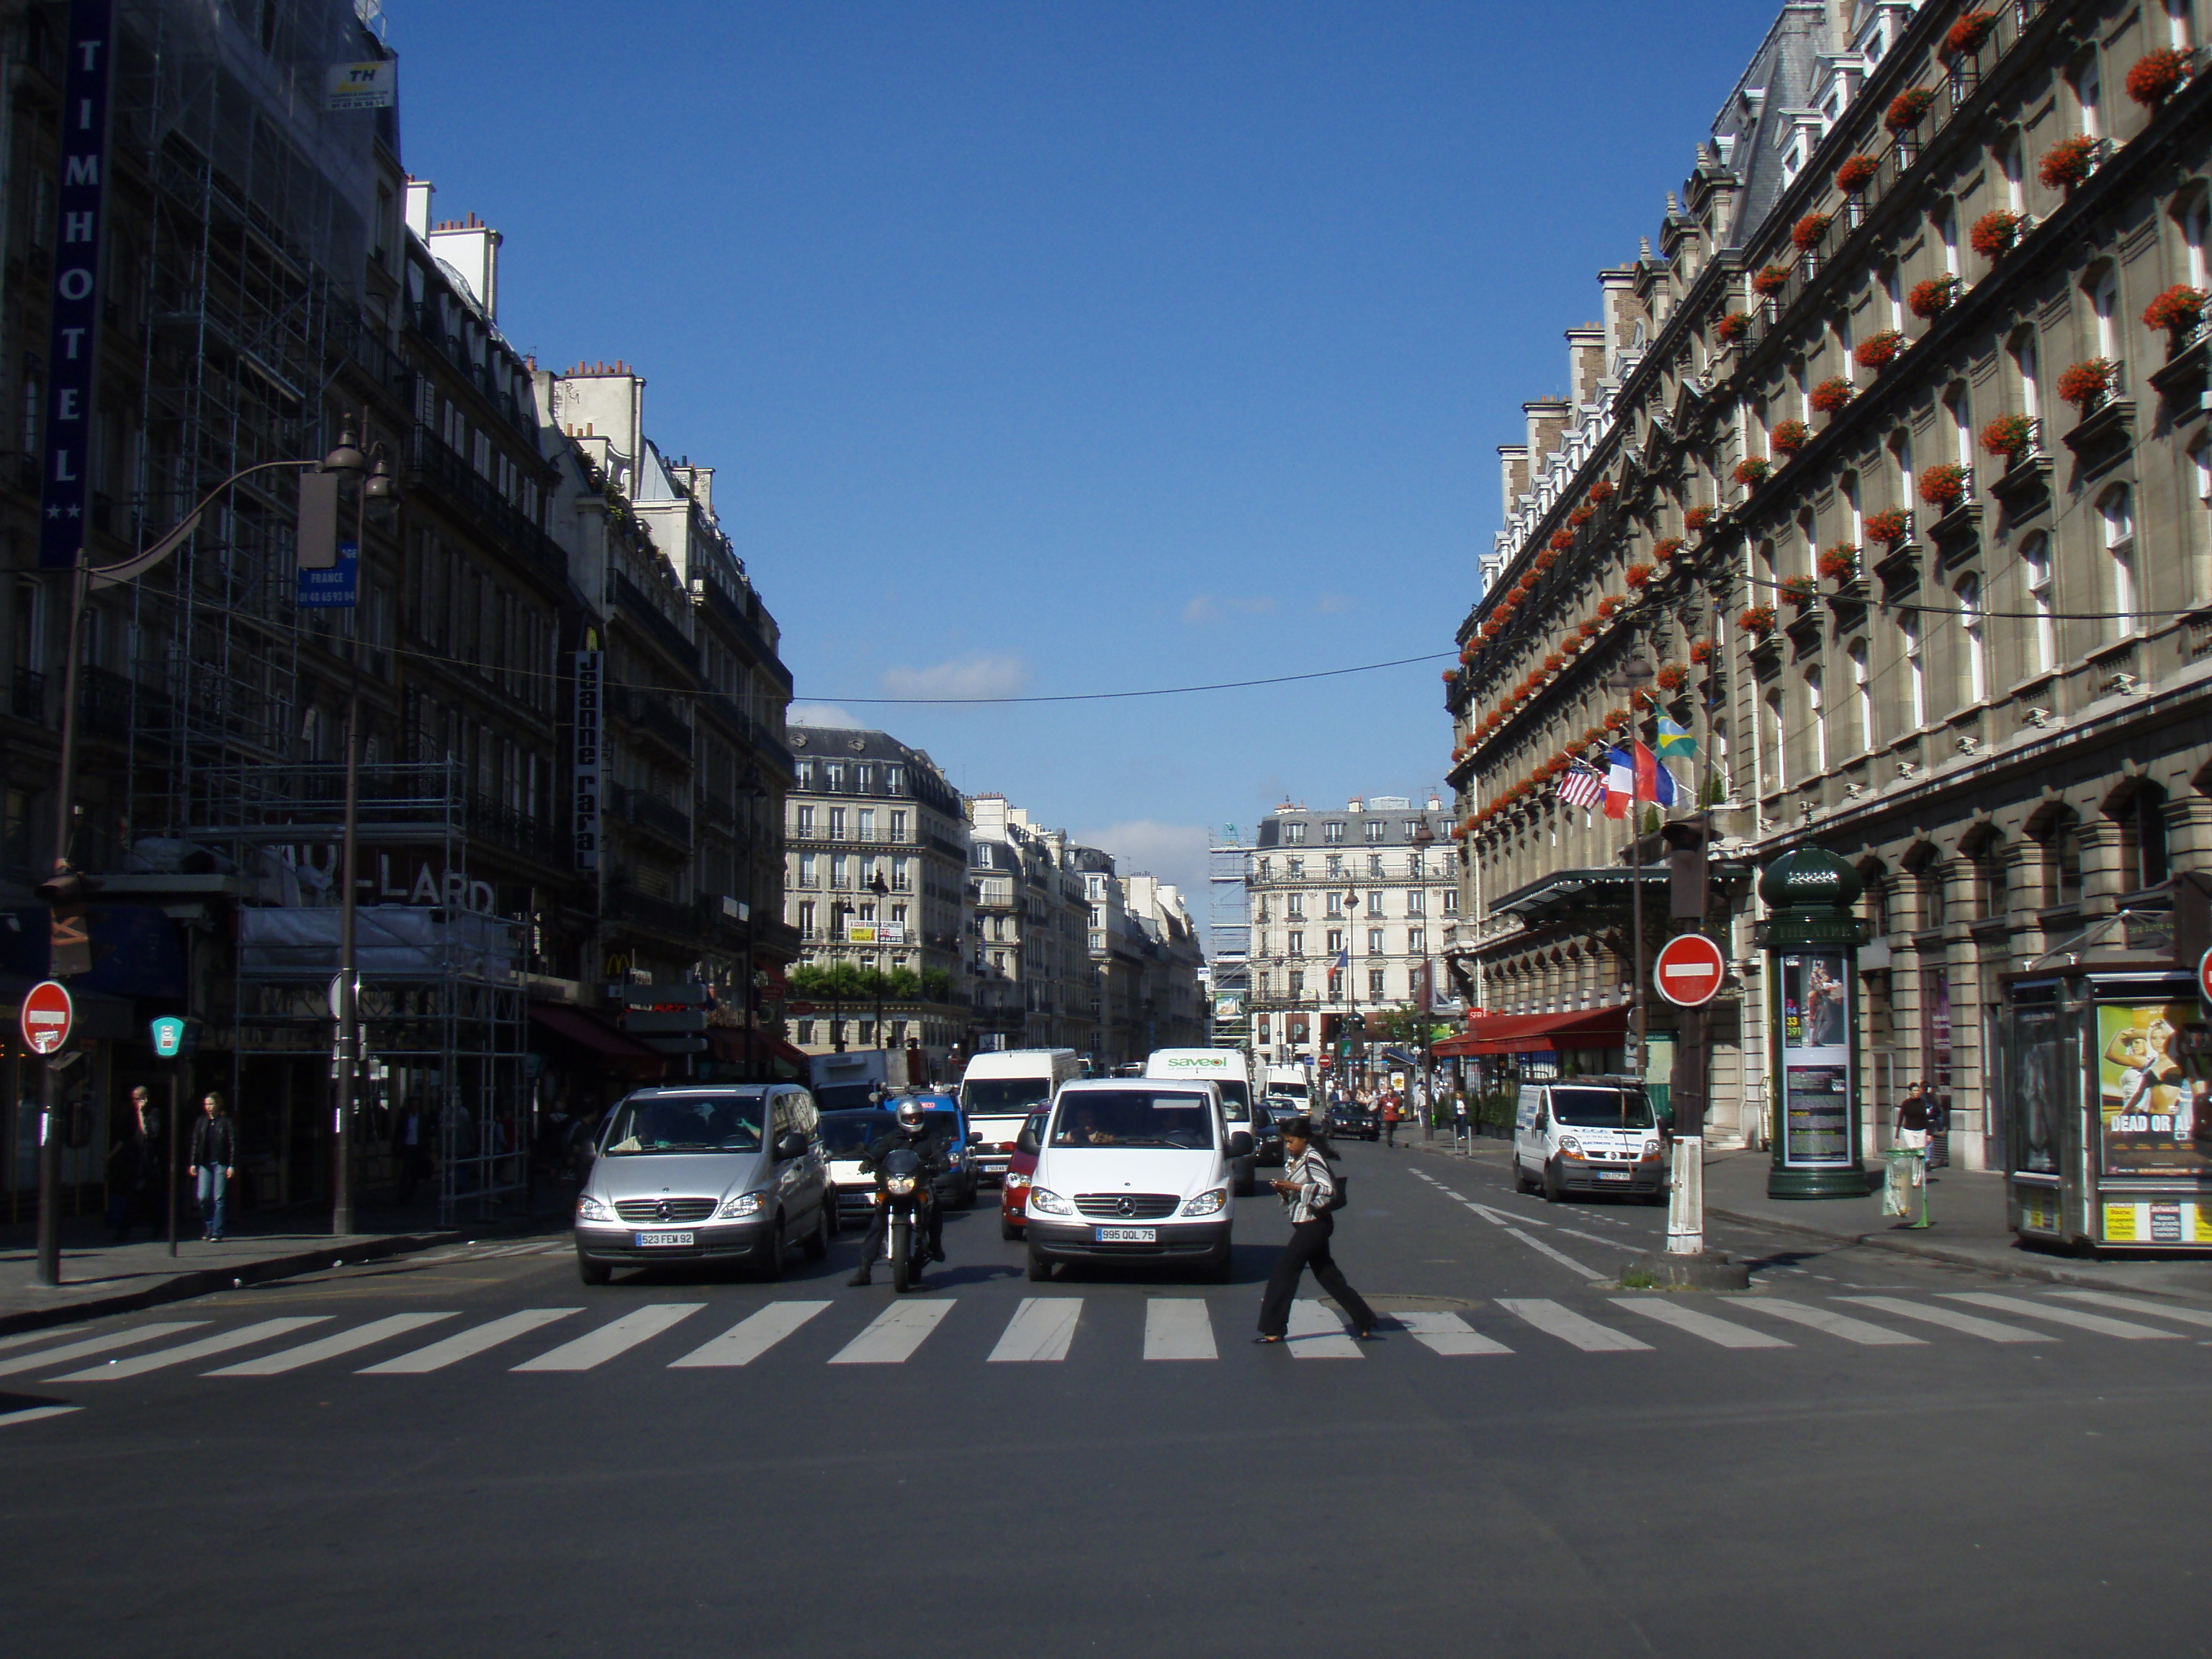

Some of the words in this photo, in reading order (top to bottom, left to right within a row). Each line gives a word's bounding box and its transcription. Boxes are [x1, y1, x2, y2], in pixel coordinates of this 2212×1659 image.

[350, 69, 377, 83] TH
[55, 39, 102, 482] TIMHOTEL
[311, 572, 344, 583] FRANCE
[1470, 1011, 1483, 1020] SFR
[1786, 1007, 1798, 1016] 94
[1786, 1016, 1799, 1026] 33
[1786, 1027, 1802, 1036] 391
[2110, 1115, 2149, 1132] DEAD
[2150, 1115, 2172, 1132] OR
[642, 1235, 659, 1244] 523
[661, 1234, 678, 1244] FEM
[680, 1233, 692, 1243] 92
[1102, 1230, 1120, 1239] 995
[1141, 1231, 1154, 1239] 75
